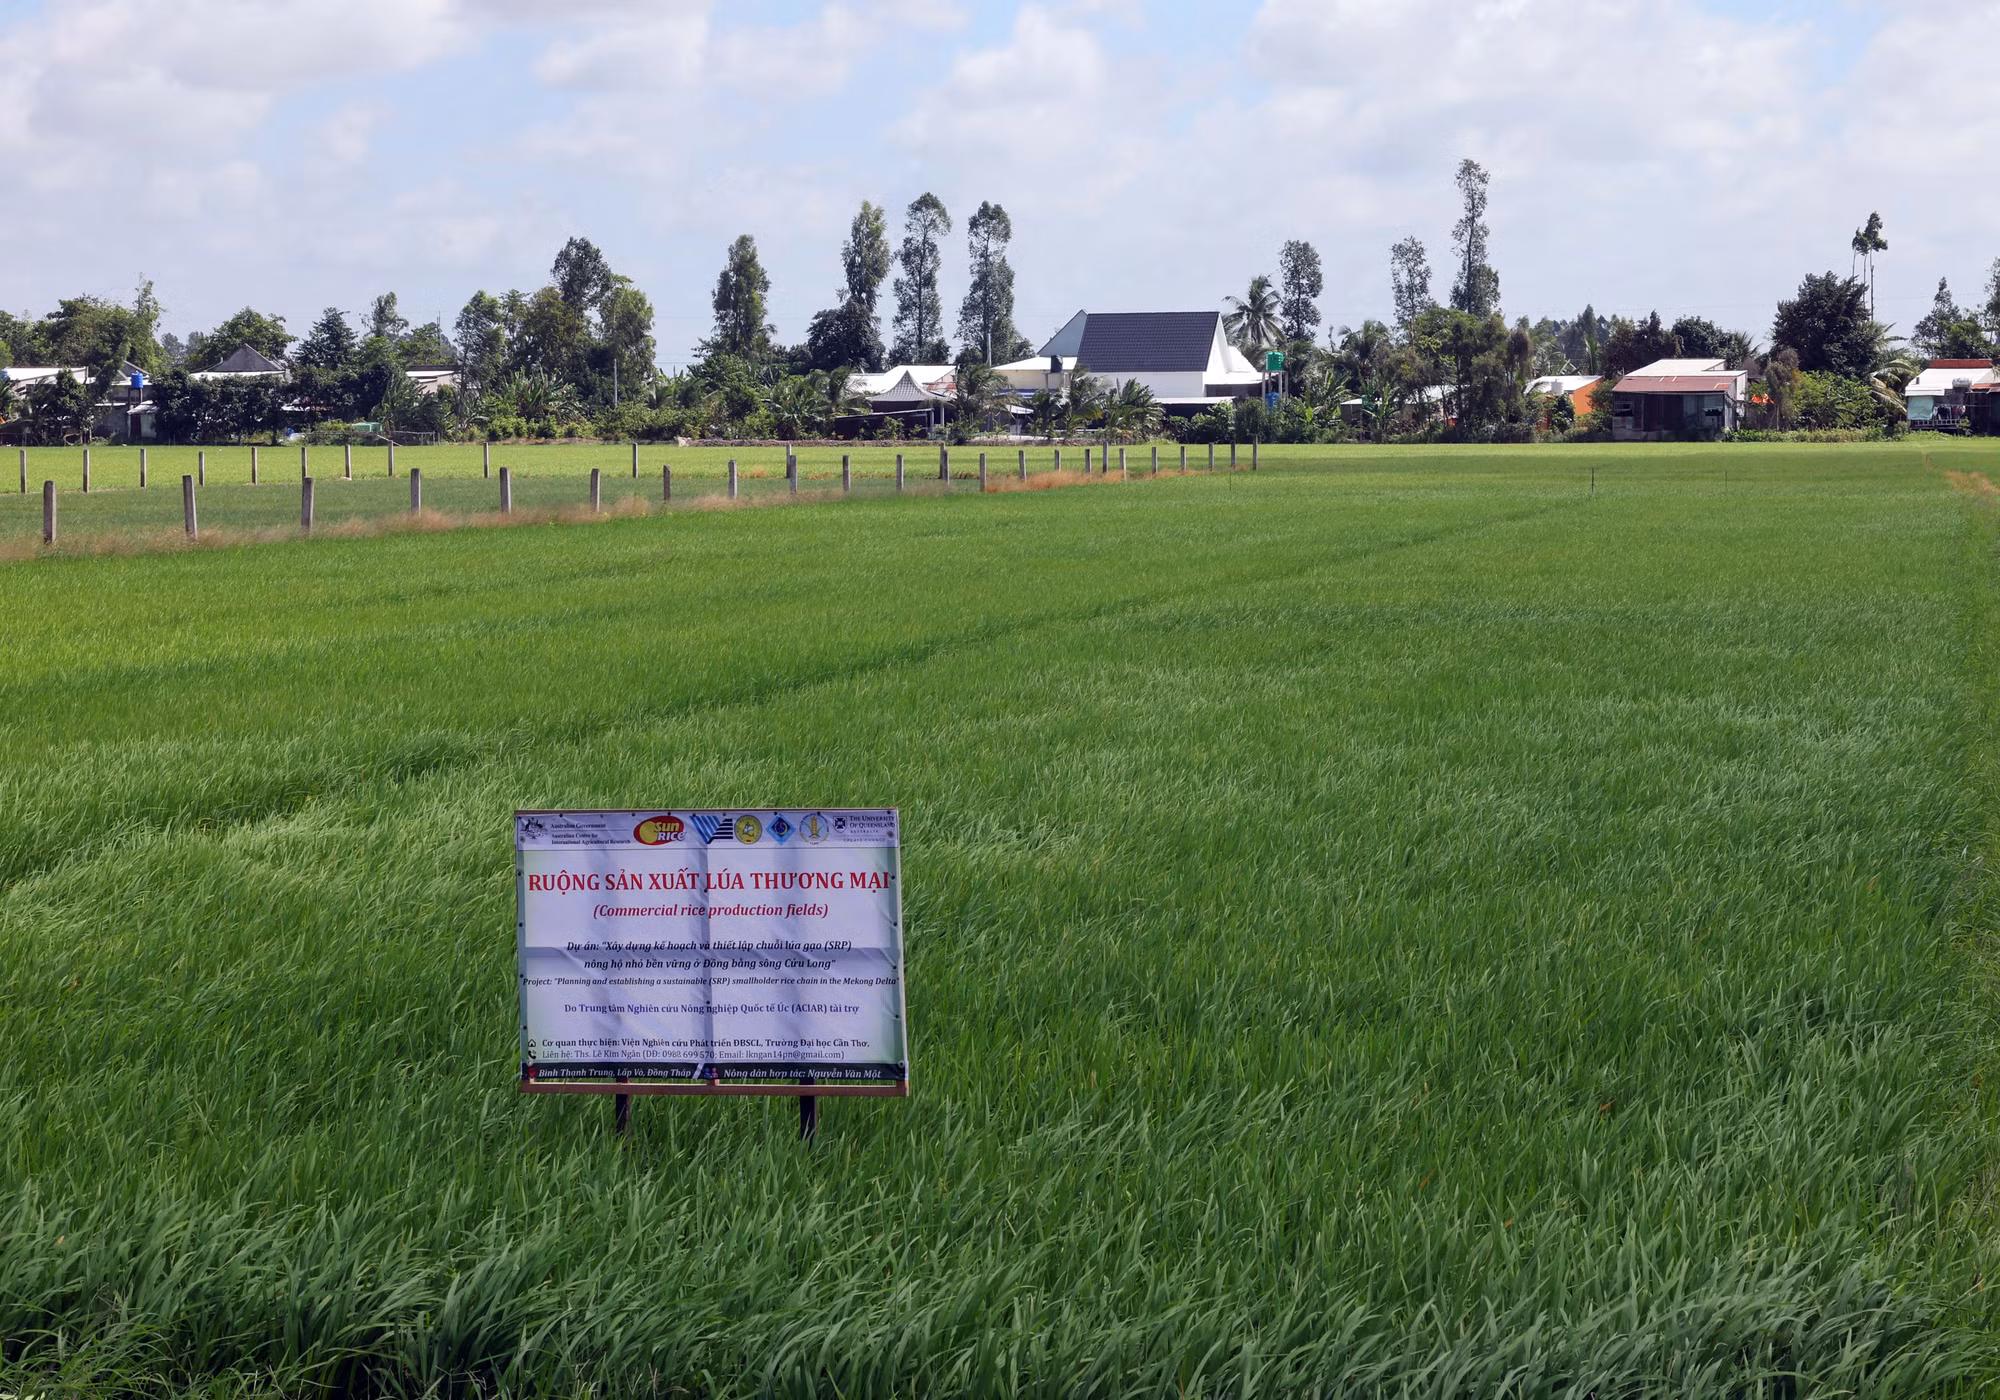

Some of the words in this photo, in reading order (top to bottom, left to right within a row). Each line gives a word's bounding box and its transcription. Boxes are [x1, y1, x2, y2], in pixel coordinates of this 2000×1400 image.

[529, 870, 600, 895] RUỘNG
[605, 869, 643, 890] SẢN
[649, 867, 699, 890] XUẤT
[706, 868, 744, 890] LÚA
[750, 872, 844, 890] THƯƠNG
[850, 872, 890, 893] MẠI
[593, 904, 677, 919] (Commercial
[681, 905, 705, 916] rice
[708, 904, 782, 919] production
[785, 903, 829, 919] fields)
[567, 941, 582, 952] Dự
[584, 941, 600, 951] án:
[626, 941, 651, 953] dựng
[654, 940, 666, 950] kế
[667, 941, 697, 952] hoạch
[699, 942, 710, 950] và
[713, 940, 737, 950] thiết
[738, 940, 754, 952] lập
[756, 940, 783, 950] chuỗi
[785, 940, 801, 950] lúa
[803, 943, 822, 952] gạo
[824, 940, 852, 952] (SRP)
[584, 959, 608, 970] nông
[610, 958, 623, 970] hộ
[625, 958, 644, 968] nhỏ
[645, 957, 663, 968] bền
[666, 958, 690, 970] vững
[693, 958, 701, 968] ở
[703, 958, 729, 970] Đồng
[731, 958, 756, 970] bằng
[758, 959, 782, 970] sông
[784, 958, 805, 968] Cửu
[522, 977, 552, 987] Project:
[592, 977, 607, 985] and
[608, 977, 655, 987] establishing
[663, 977, 707, 985] sustainable
[708, 977, 730, 986] (SRP)
[732, 977, 779, 985] smallholder
[780, 977, 795, 985] rice
[797, 977, 818, 985] chain
[820, 977, 828, 985] in
[829, 977, 841, 985] the
[843, 977, 874, 987] Mekong
[564, 1004, 577, 1012] Do
[579, 1004, 608, 1014] Trung
[608, 1004, 625, 1012] tâm
[627, 1004, 659, 1014] Nghiên
[661, 1004, 679, 1012] cứu
[681, 1004, 705, 1014] Nông
[706, 1004, 738, 1014] nghiệp
[740, 1004, 764, 1014] Quốc
[766, 1003, 776, 1012] tế
[777, 1002, 790, 1012] Úc
[791, 1003, 827, 1014] (ACIAR)
[830, 1004, 842, 1012] tài
[844, 1004, 860, 1014] trợ
[542, 1039, 554, 1047] Cơ
[555, 1040, 576, 1049] quan
[578, 1039, 597, 1048] thực
[599, 1038, 620, 1048] hiện:
[621, 1038, 640, 1048] Viện
[642, 1038, 670, 1048] Nghiên
[671, 1039, 688, 1047] cứu
[690, 1039, 709, 1047] Phát
[710, 1039, 732, 1047] triển
[733, 1039, 763, 1048] ĐBSCL,
[765, 1039, 798, 1048] Trường
[800, 1039, 815, 1048] Đại
[816, 1039, 831, 1048] học
[833, 1038, 849, 1047] Cần
[542, 1050, 559, 1058] Liên
[574, 1050, 592, 1058] Ths.
[592, 1050, 603, 1058] Lê
[603, 1050, 619, 1058] Kim
[620, 1050, 641, 1059] Ngân
[682, 1050, 698, 1058] 699
[719, 1050, 744, 1058] Email:
[538, 1068, 558, 1077] Bình
[560, 1068, 587, 1078] Thạnh
[588, 1068, 616, 1078] Trung,
[617, 1067, 632, 1078] Lấp
[647, 1067, 668, 1078] Đồng
[670, 1068, 691, 1078] Tháp
[723, 1069, 748, 1079] Nông
[750, 1069, 767, 1078] dân
[769, 1069, 787, 1079] hợp
[807, 1068, 842, 1079] Nguyễn
[845, 1068, 862, 1078] Văn
[864, 1068, 881, 1079] Một
